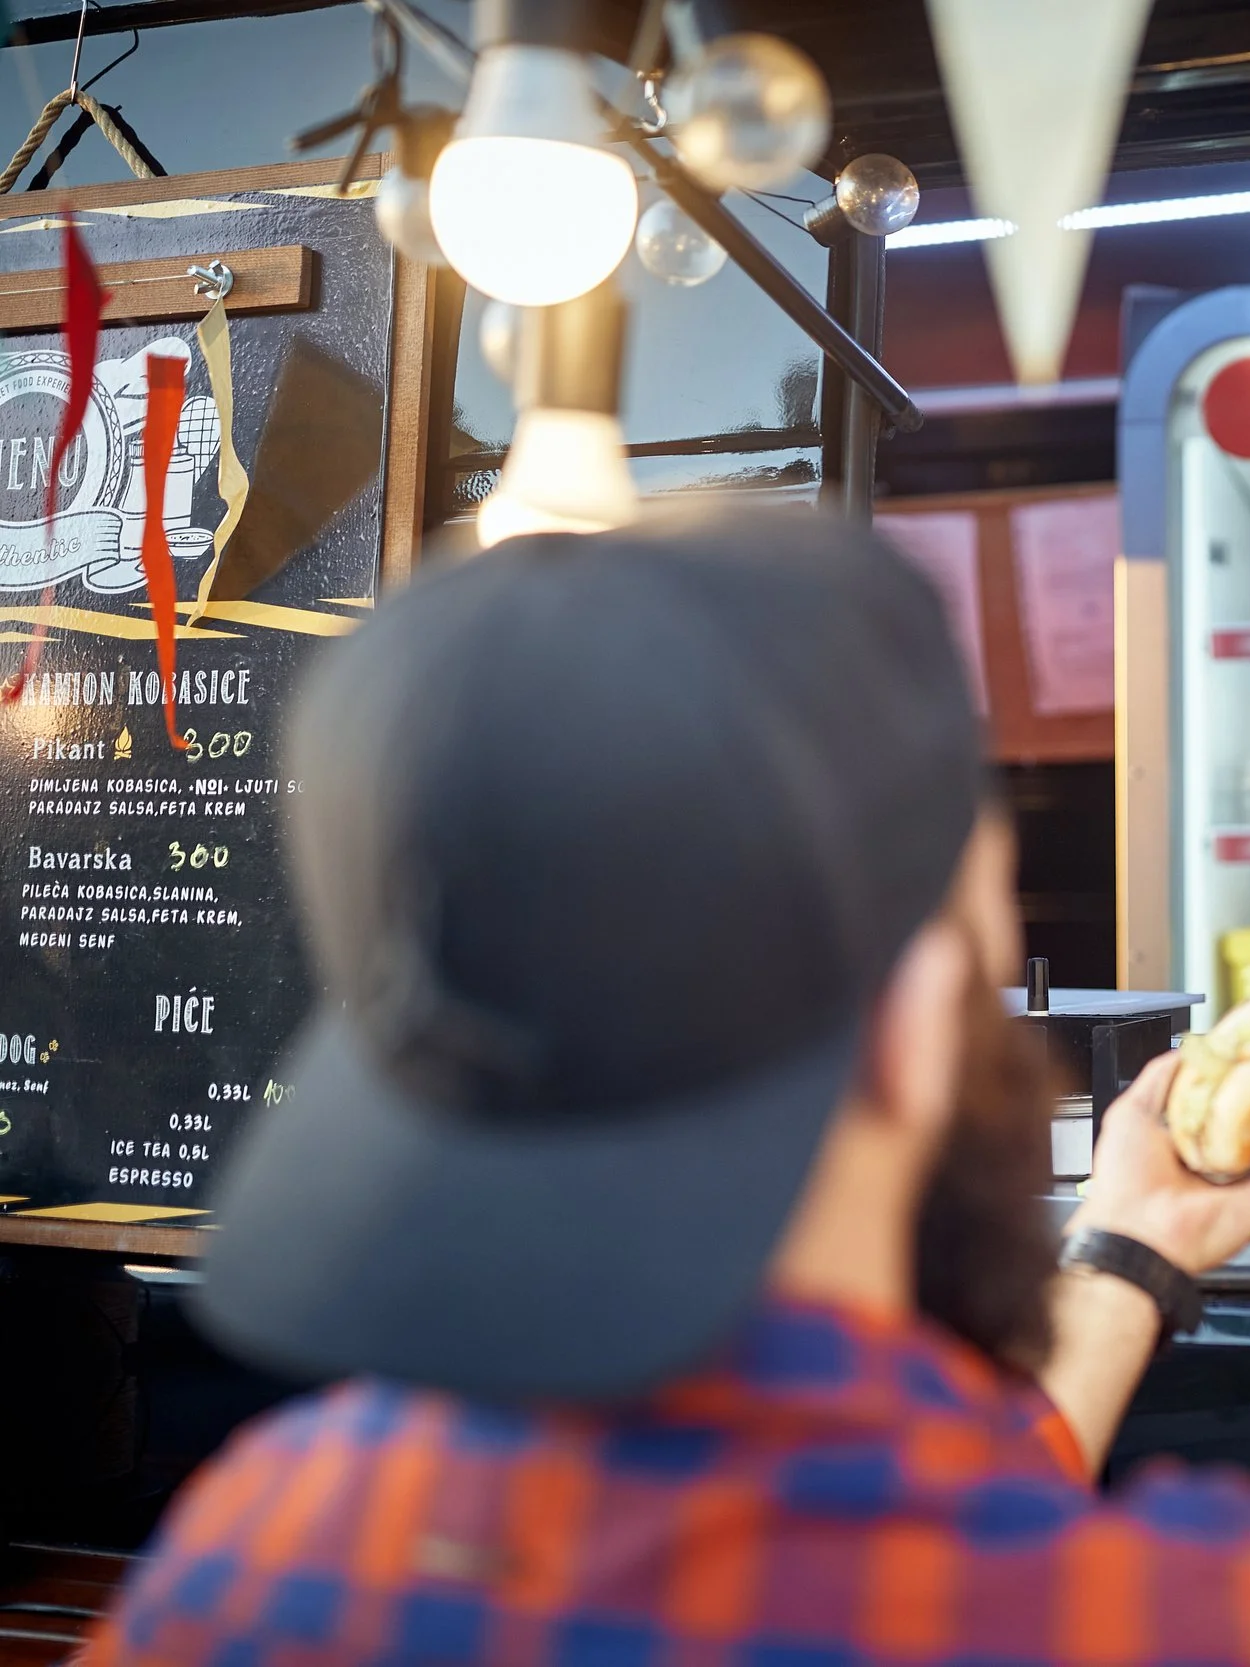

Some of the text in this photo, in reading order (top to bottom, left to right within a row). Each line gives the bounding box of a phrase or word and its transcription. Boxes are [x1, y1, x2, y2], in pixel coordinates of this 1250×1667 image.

[0, 375, 72, 399] ET FOOD EXPERIE
[0, 434, 82, 490] ENU
[22, 671, 115, 706] KAMION
[33, 737, 105, 762] Pikant
[183, 727, 252, 764] 300
[29, 778, 99, 793] DIMLJENA
[106, 778, 182, 795] KOBASICA,
[234, 779, 279, 794] LJUTI
[204, 801, 246, 816] KREM
[28, 845, 132, 871] Bavarska
[20, 906, 94, 921] PARADAJZ
[196, 910, 243, 927] KREM,
[19, 932, 116, 949] MEDENI SENF
[154, 986, 215, 1034] PIĆE
[23, 1079, 49, 1095] Senf
[207, 1083, 252, 1101] 0,33L
[169, 1113, 212, 1131] 0,33L
[110, 1140, 210, 1161] ICE TEA 0,5L
[108, 1167, 193, 1188] ESPRESSO
